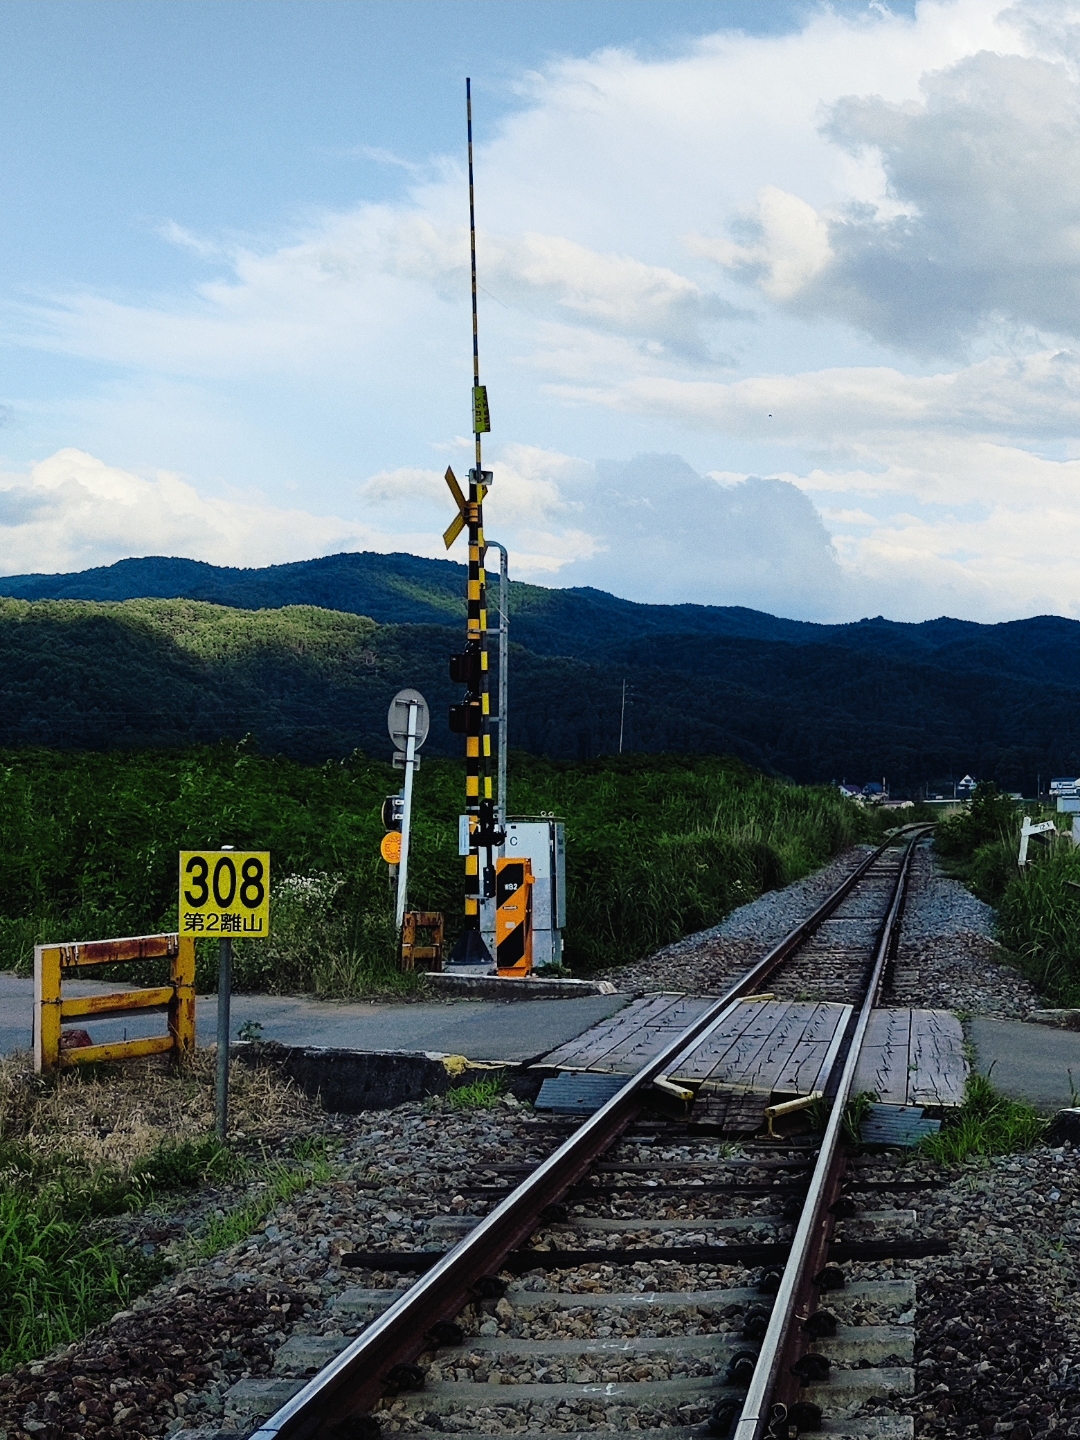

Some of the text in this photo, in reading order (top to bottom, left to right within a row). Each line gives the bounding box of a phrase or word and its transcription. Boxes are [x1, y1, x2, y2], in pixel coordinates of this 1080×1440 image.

[509, 836, 518, 846] C
[184, 855, 265, 909] 308
[183, 912, 263, 933] 第2離山
